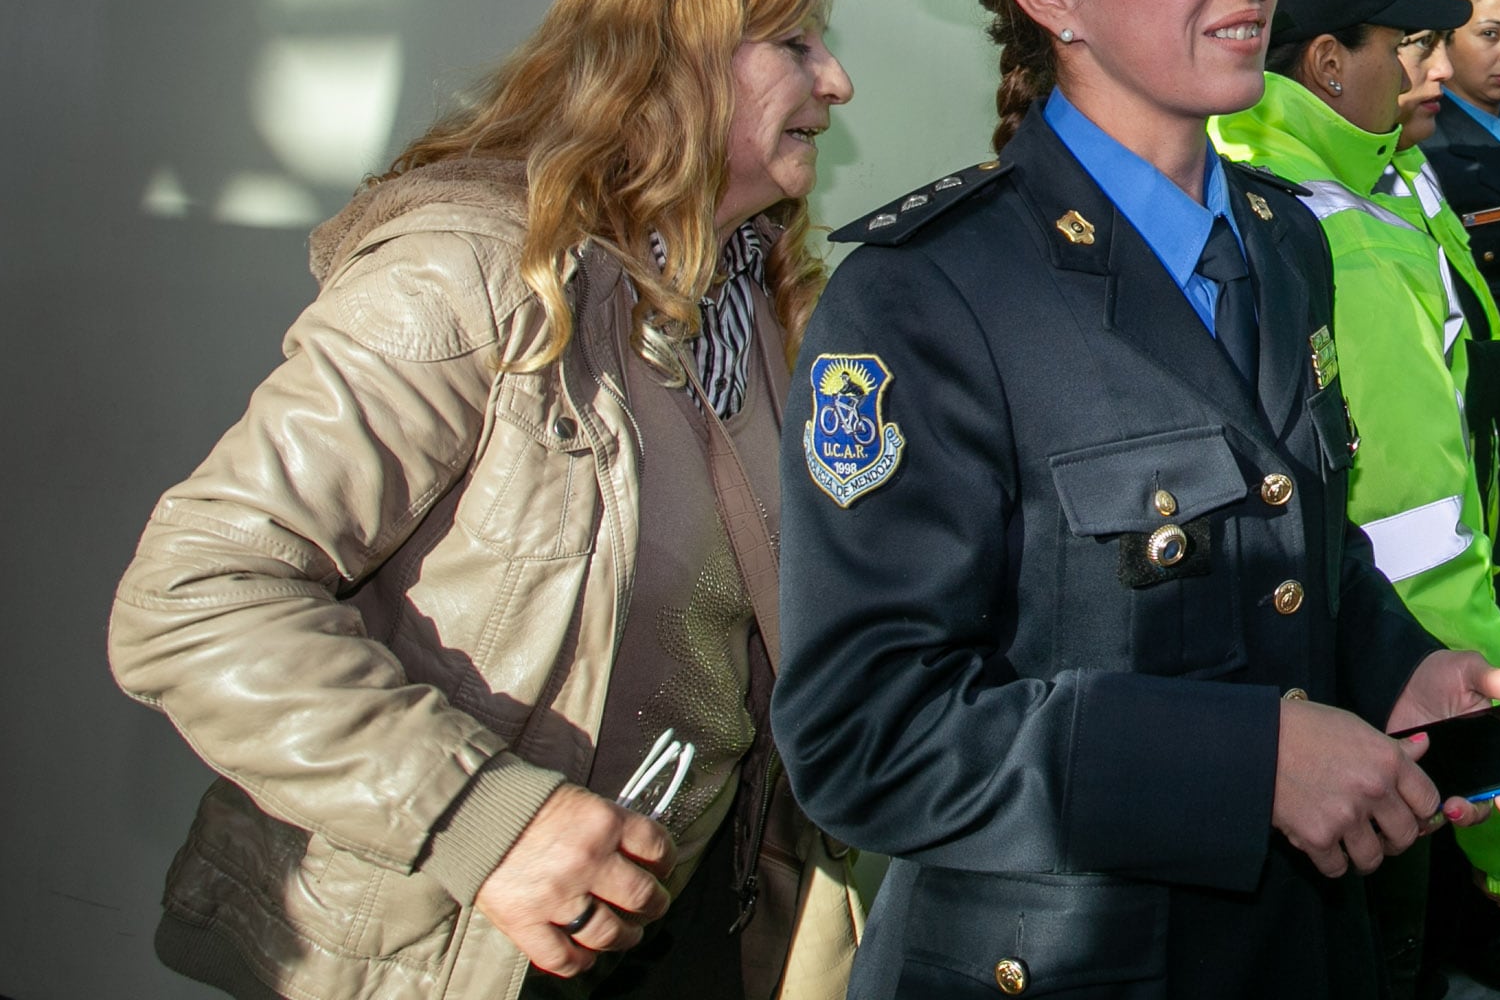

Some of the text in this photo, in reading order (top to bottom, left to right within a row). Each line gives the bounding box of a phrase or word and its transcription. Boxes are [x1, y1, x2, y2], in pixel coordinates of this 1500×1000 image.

[823, 442, 869, 459] U.C.A.R.
[833, 461, 857, 475] 1998
[836, 485, 850, 498] DE
[850, 454, 894, 491] MENDOZA
